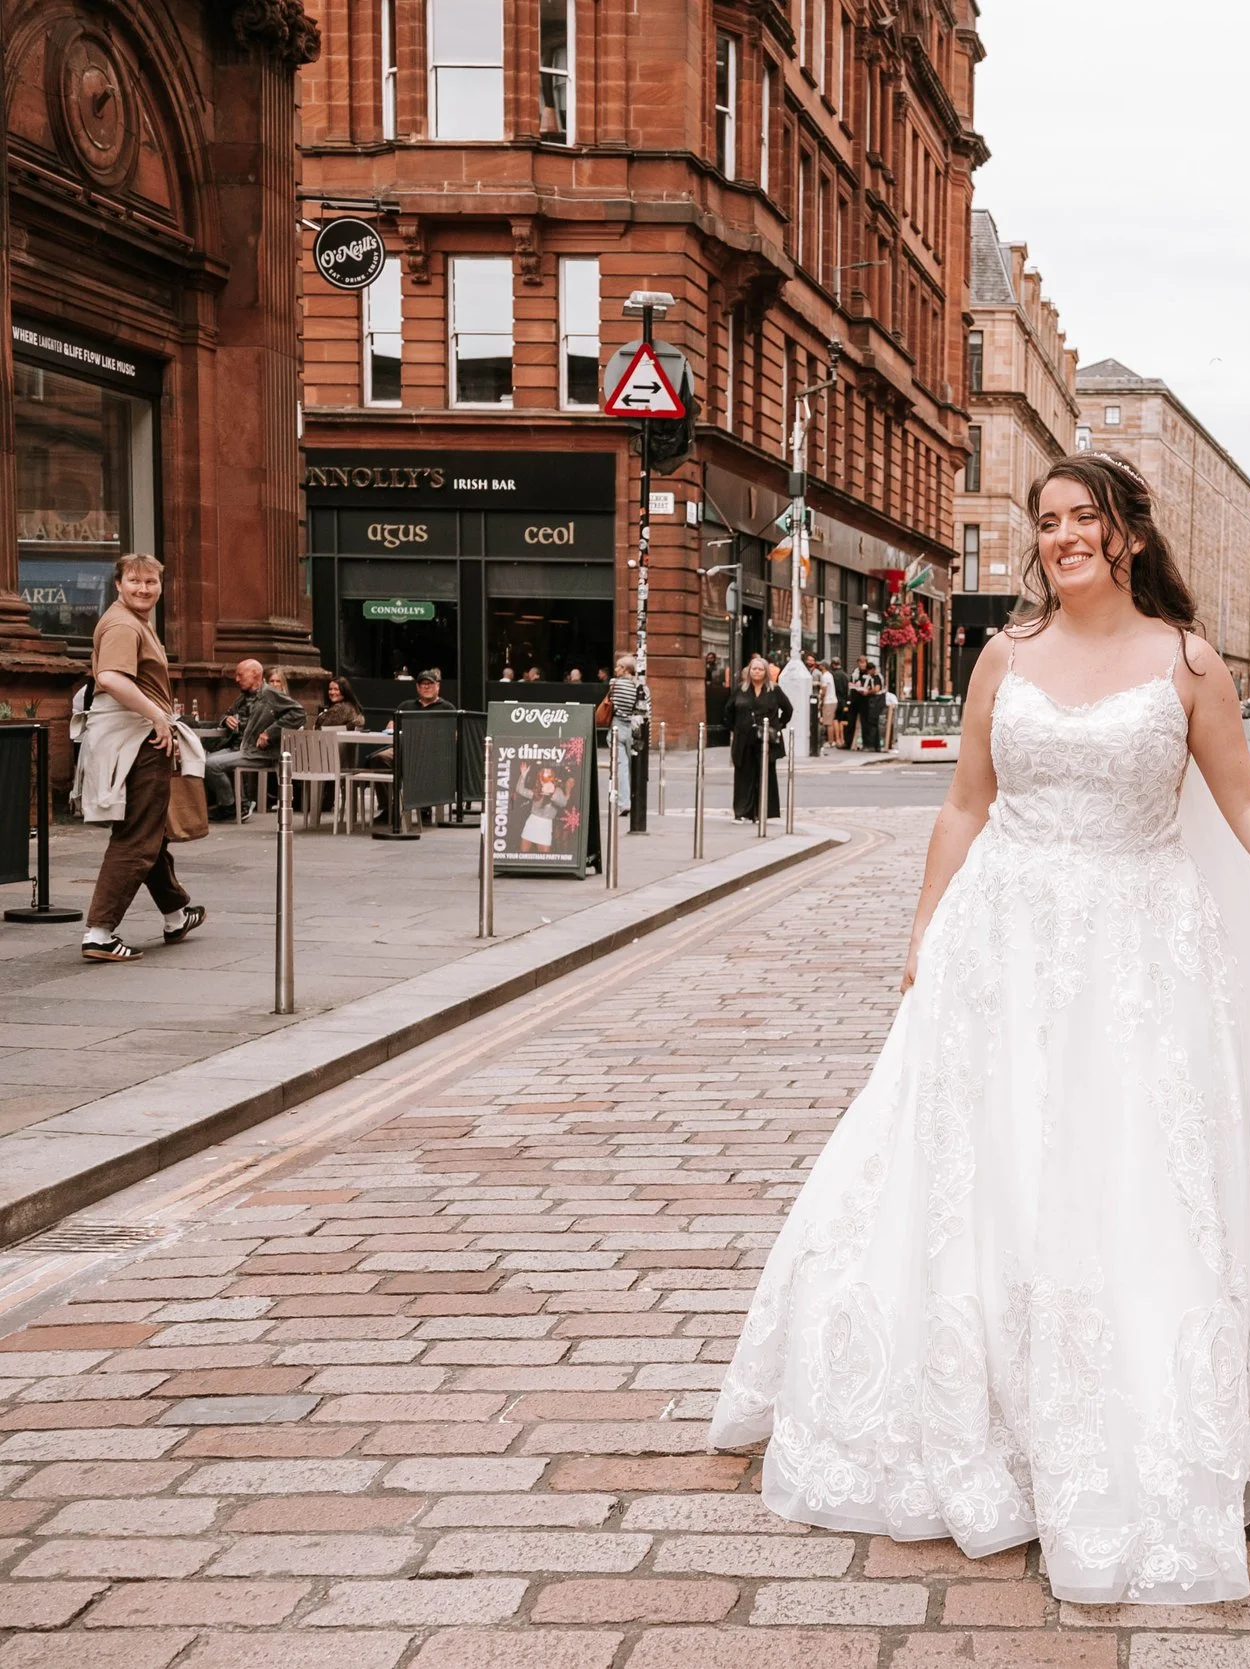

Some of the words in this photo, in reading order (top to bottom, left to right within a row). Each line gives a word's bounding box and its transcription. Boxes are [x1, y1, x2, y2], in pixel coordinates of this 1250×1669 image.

[320, 235, 377, 268] O'Neill's
[328, 269, 341, 280] EAT
[345, 273, 366, 283] DRINK
[367, 251, 379, 273] ENJOY
[12, 325, 39, 346] WHERE
[38, 334, 63, 353] LAUGHTER
[83, 348, 101, 366] FLOW
[101, 355, 116, 370] LIKE
[116, 361, 136, 377] MUSIC
[306, 466, 445, 488] NNOLLY'S
[453, 478, 488, 490] IRISH
[491, 479, 516, 491] BAR
[367, 523, 429, 548] agus
[524, 522, 575, 545] ceol
[371, 606, 425, 615] CONNOLLY'S
[510, 707, 569, 728] O'Neill's
[498, 747, 516, 762] ye
[518, 743, 567, 763] thirsty
[497, 760, 511, 789] ALL
[495, 790, 509, 837] COME
[493, 839, 507, 852] O
